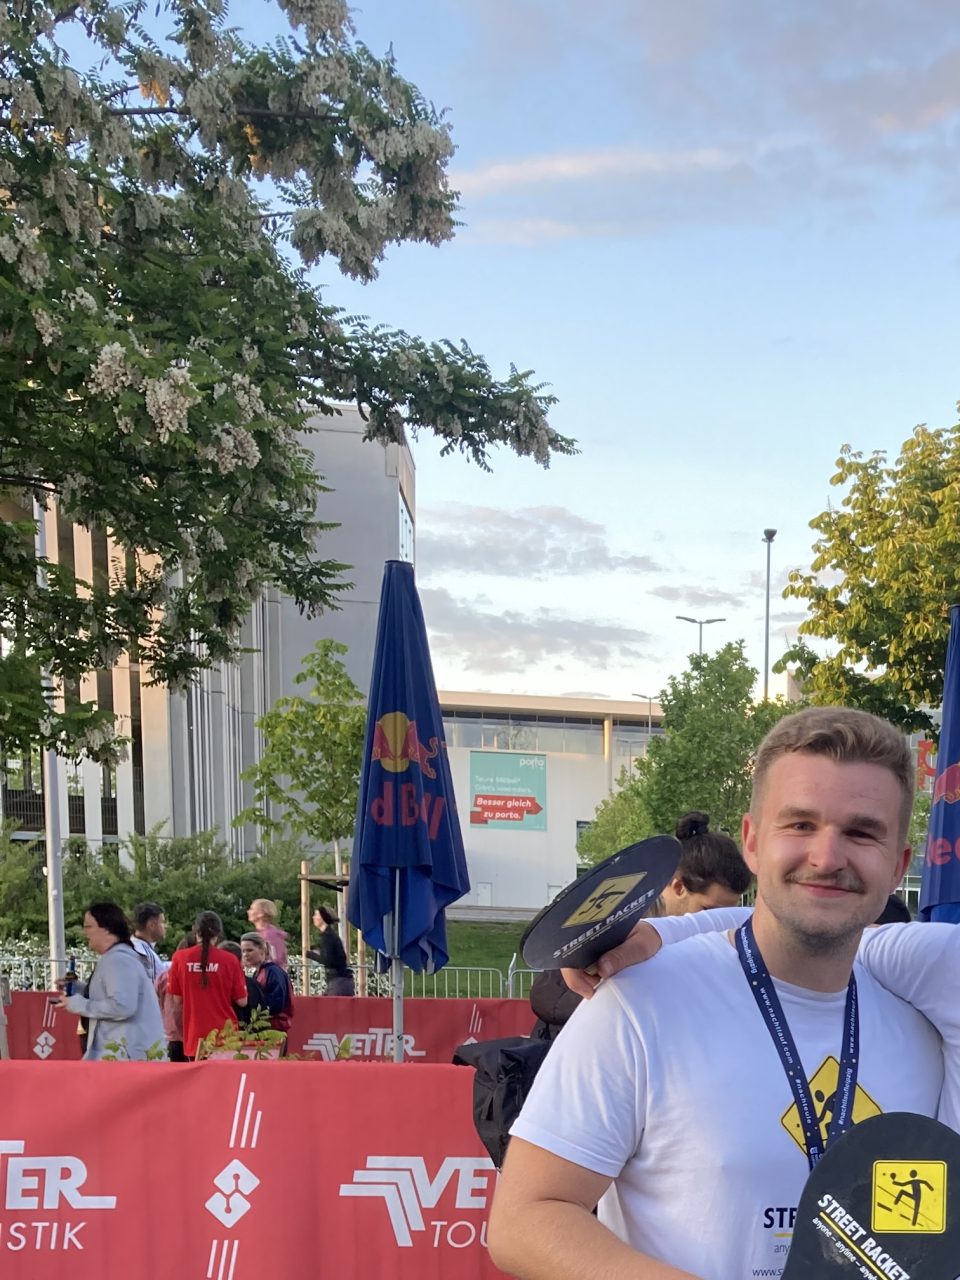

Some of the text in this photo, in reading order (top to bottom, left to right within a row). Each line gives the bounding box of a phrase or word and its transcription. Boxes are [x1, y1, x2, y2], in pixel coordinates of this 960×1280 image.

[477, 797, 532, 808] Besser gleich
[553, 922, 602, 959] STREET
[606, 888, 655, 924] RACKET
[812, 1217, 832, 1238] anyone
[835, 1240, 856, 1263] anytime
[818, 1194, 866, 1240] STREET
